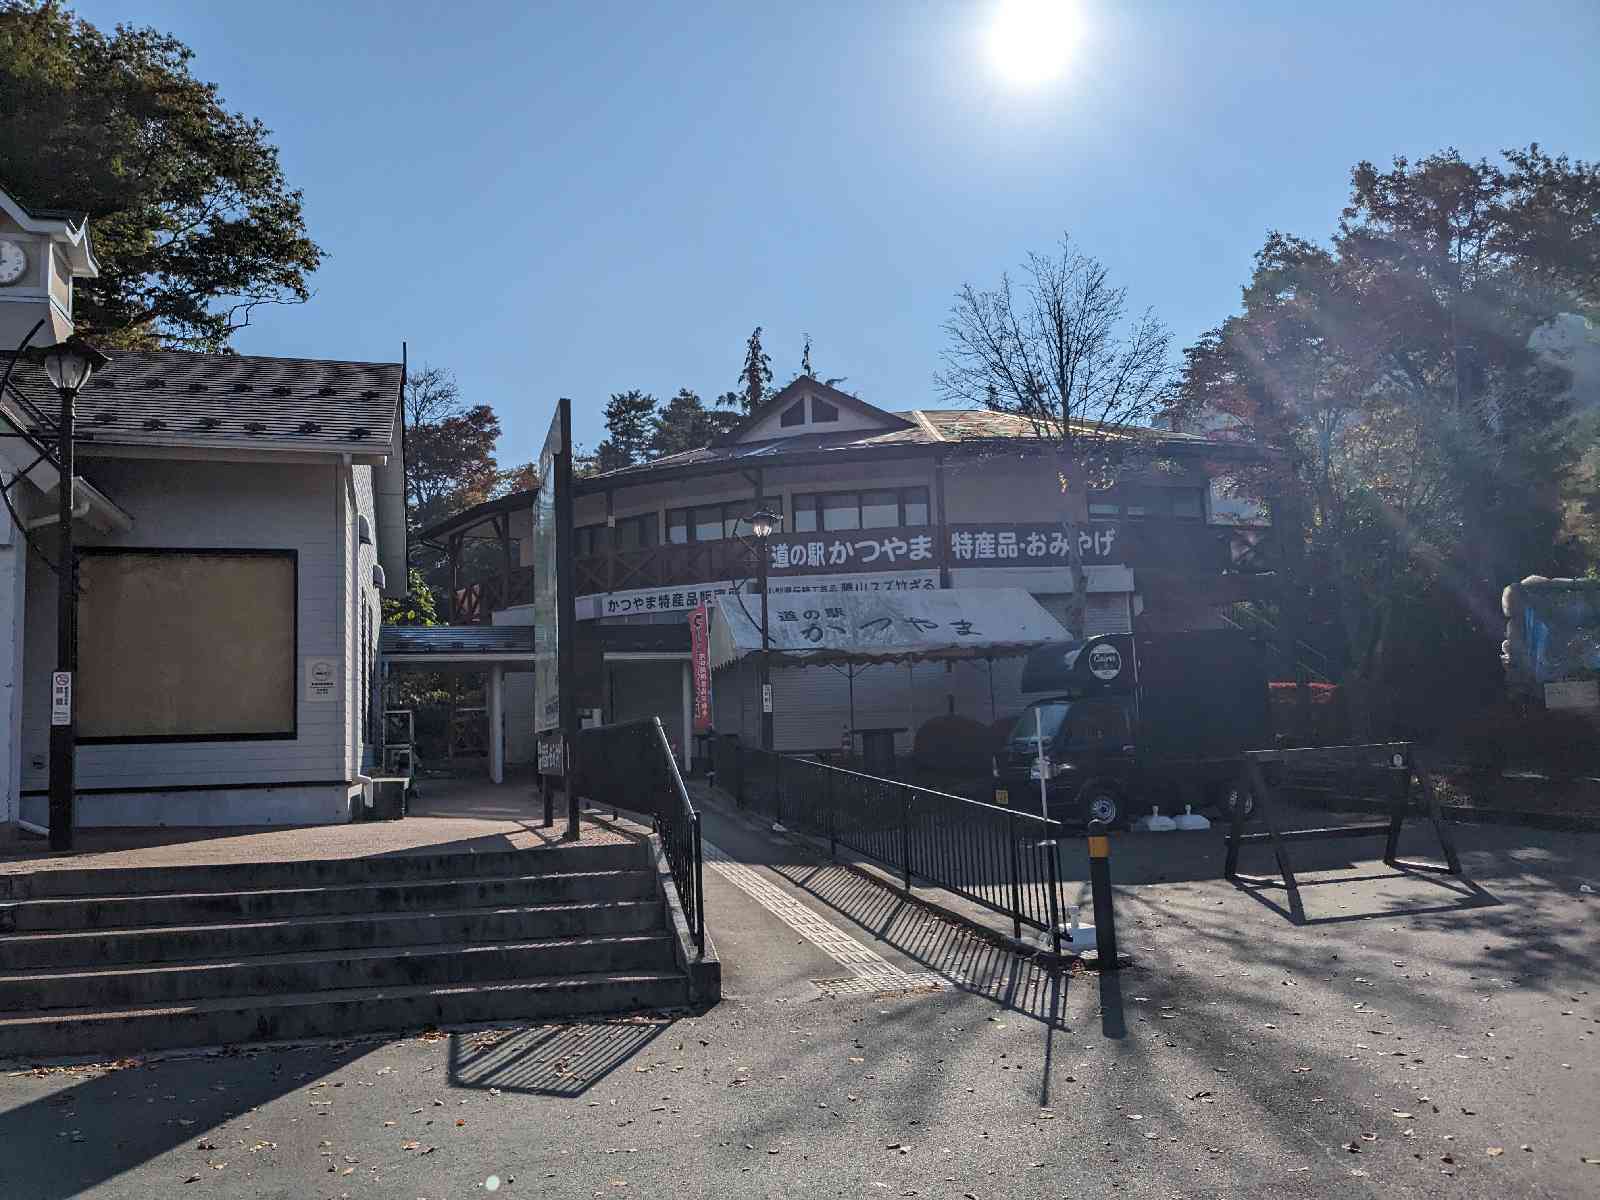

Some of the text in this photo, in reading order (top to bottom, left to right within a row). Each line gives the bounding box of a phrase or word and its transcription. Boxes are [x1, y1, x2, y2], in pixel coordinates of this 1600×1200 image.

[771, 535, 933, 568] 道の駅かつやま
[800, 617, 984, 643] かつやま
